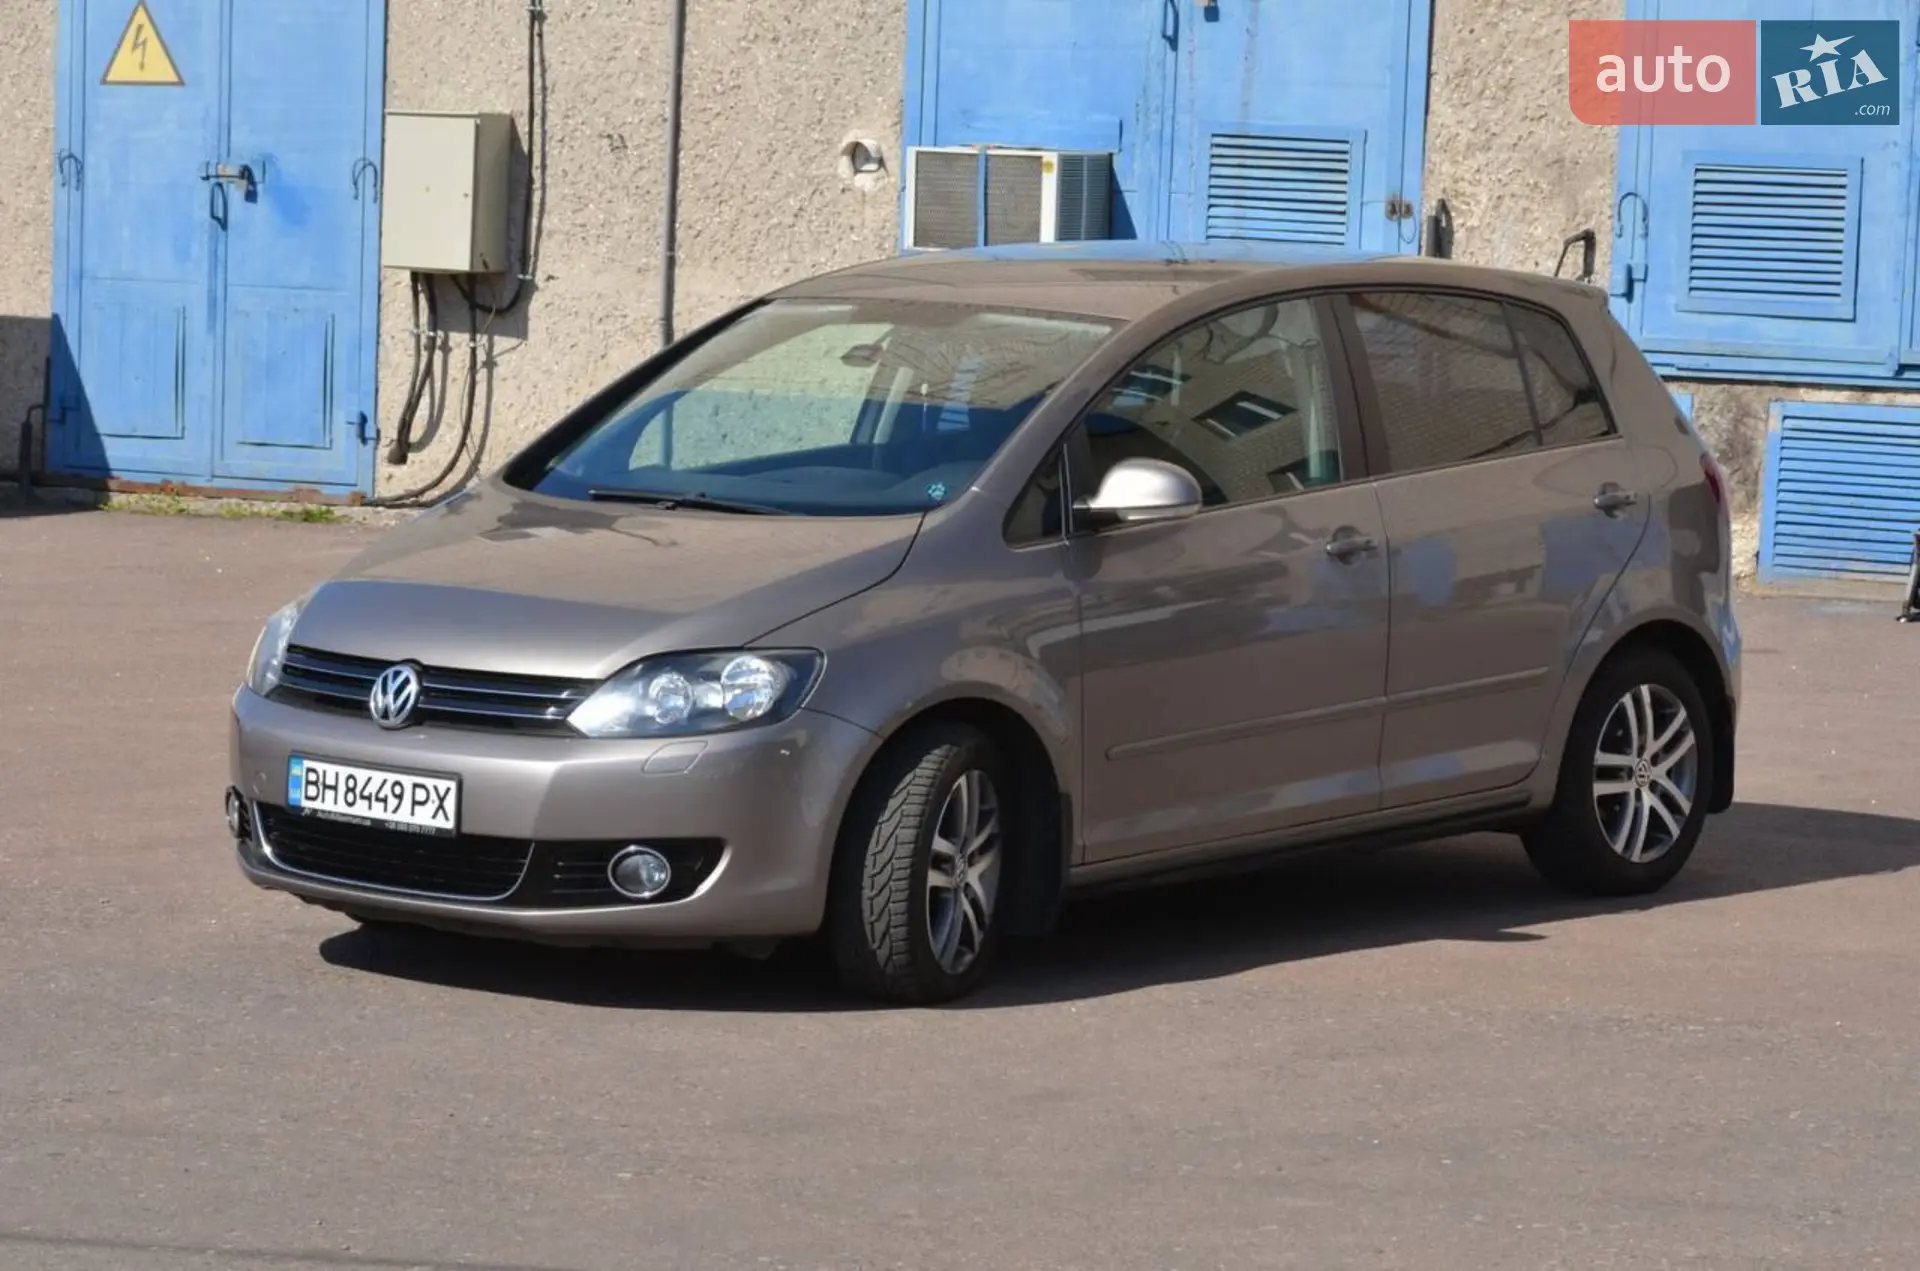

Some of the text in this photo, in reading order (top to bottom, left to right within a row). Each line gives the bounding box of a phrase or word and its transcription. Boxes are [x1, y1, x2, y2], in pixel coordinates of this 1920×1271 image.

[304, 766, 339, 806] BH
[343, 773, 405, 815] 8449
[410, 782, 452, 822] PX
